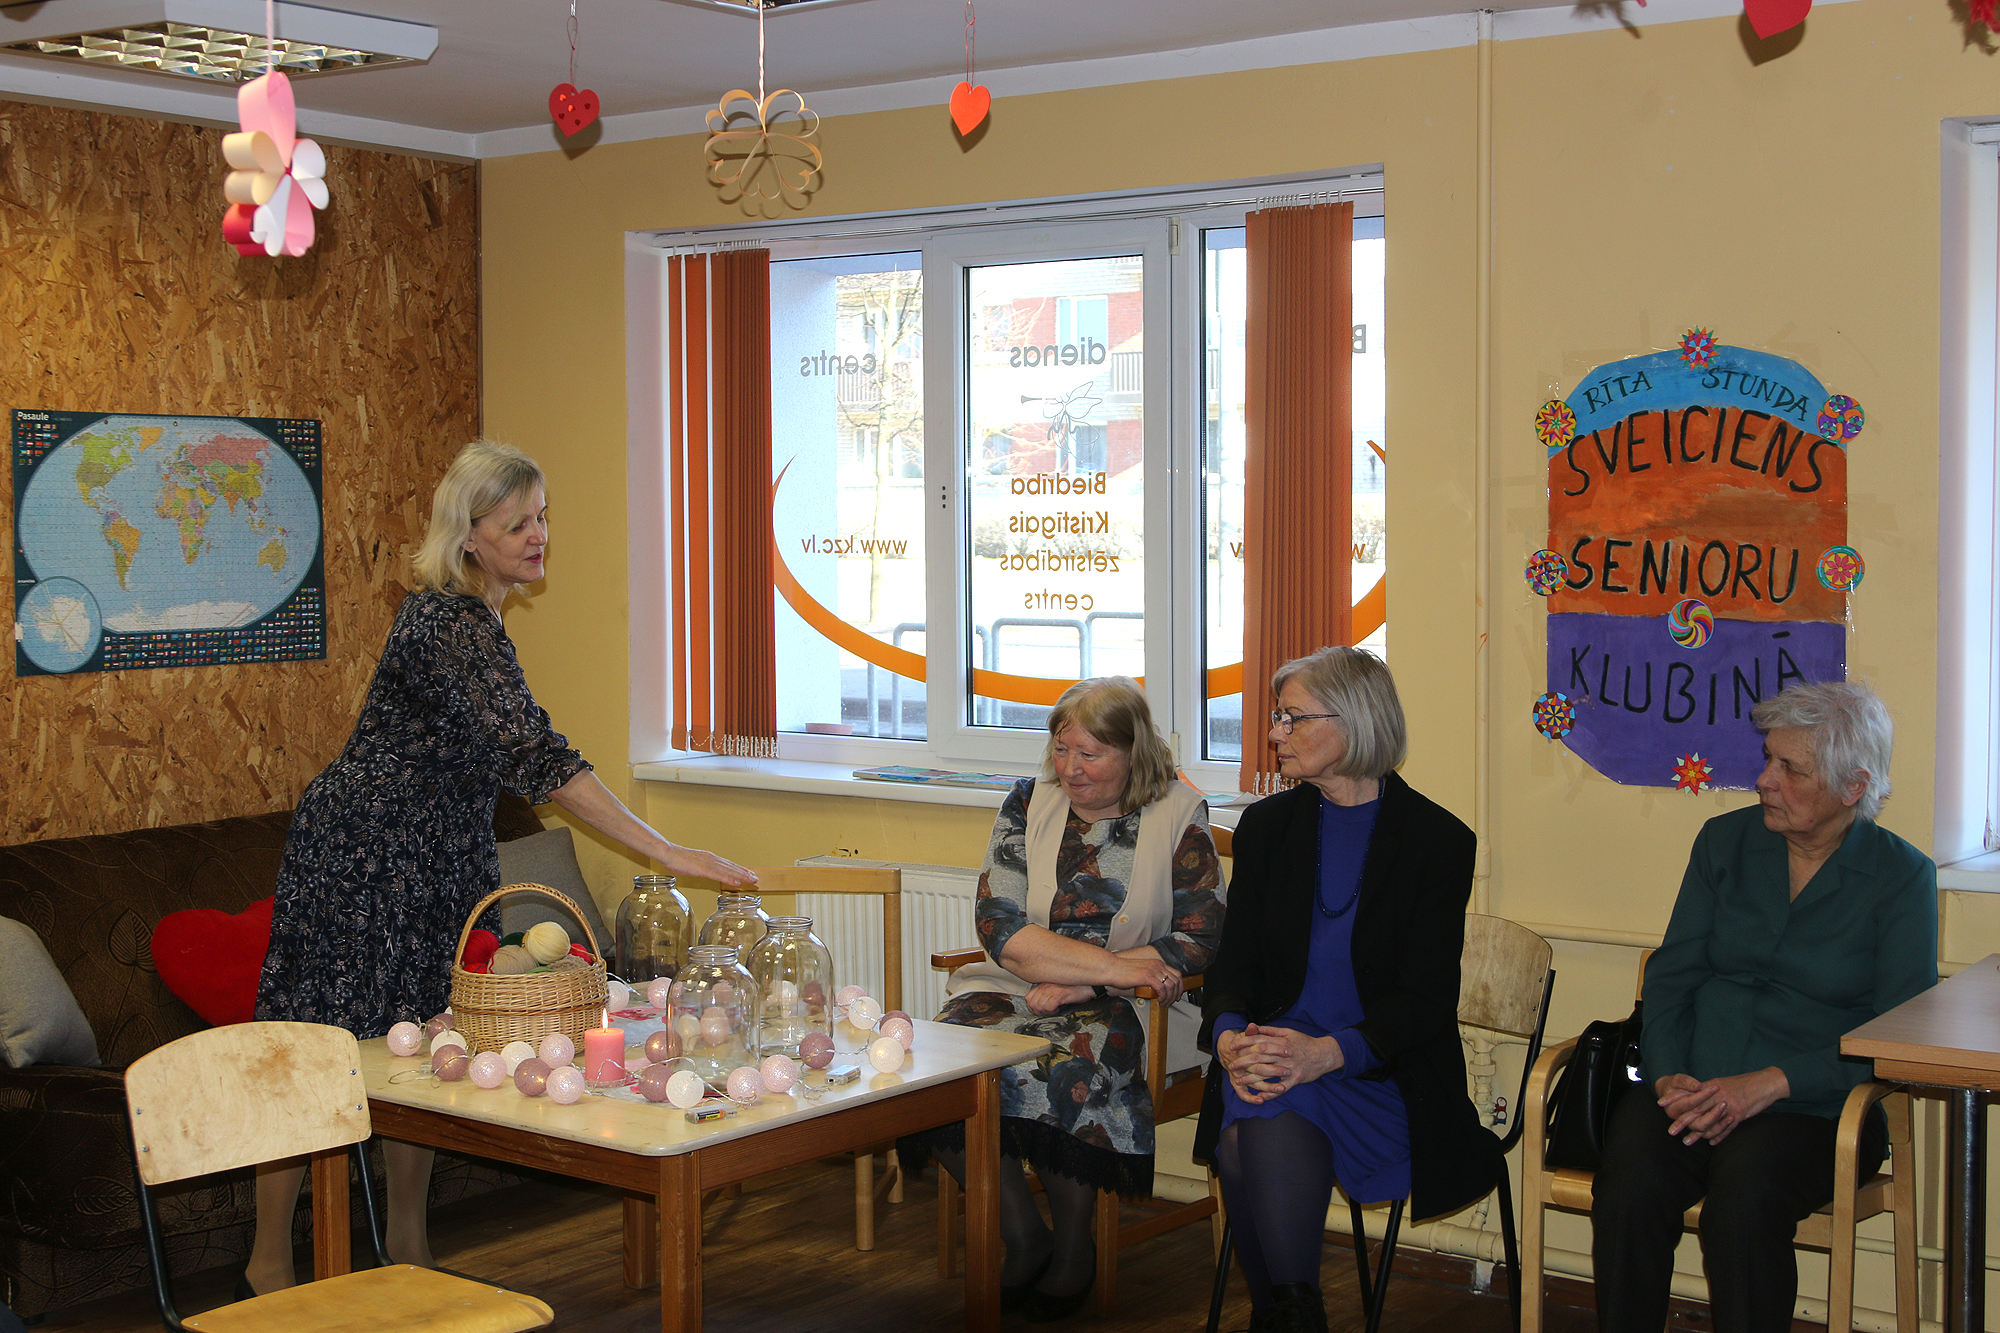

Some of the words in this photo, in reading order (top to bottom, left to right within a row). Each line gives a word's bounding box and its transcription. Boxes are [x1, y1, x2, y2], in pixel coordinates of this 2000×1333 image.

[17, 411, 50, 421] Pasaule
[1583, 370, 1652, 415] RĪTA
[1701, 367, 1810, 421] STUNDA
[1563, 405, 1839, 496] SVEICIENS
[1566, 537, 1799, 603] SENIORU
